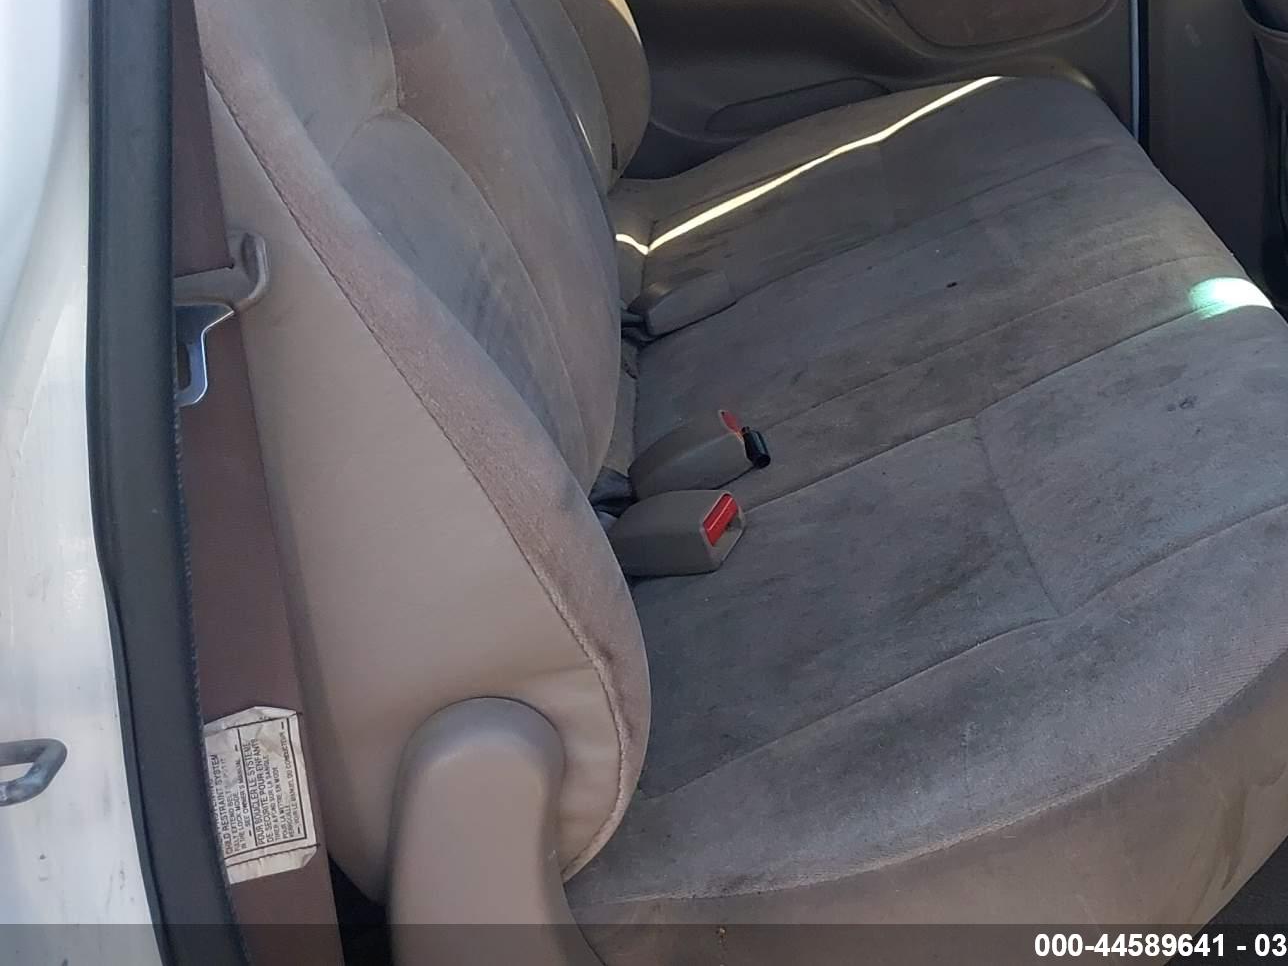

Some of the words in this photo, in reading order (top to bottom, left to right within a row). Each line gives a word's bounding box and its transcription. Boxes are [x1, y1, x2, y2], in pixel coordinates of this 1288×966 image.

[210, 753, 222, 785] SYSTEM
[256, 772, 266, 795] POUR
[215, 787, 229, 830] RESTRAINT
[232, 791, 240, 811] MODE
[255, 824, 265, 844] POUR
